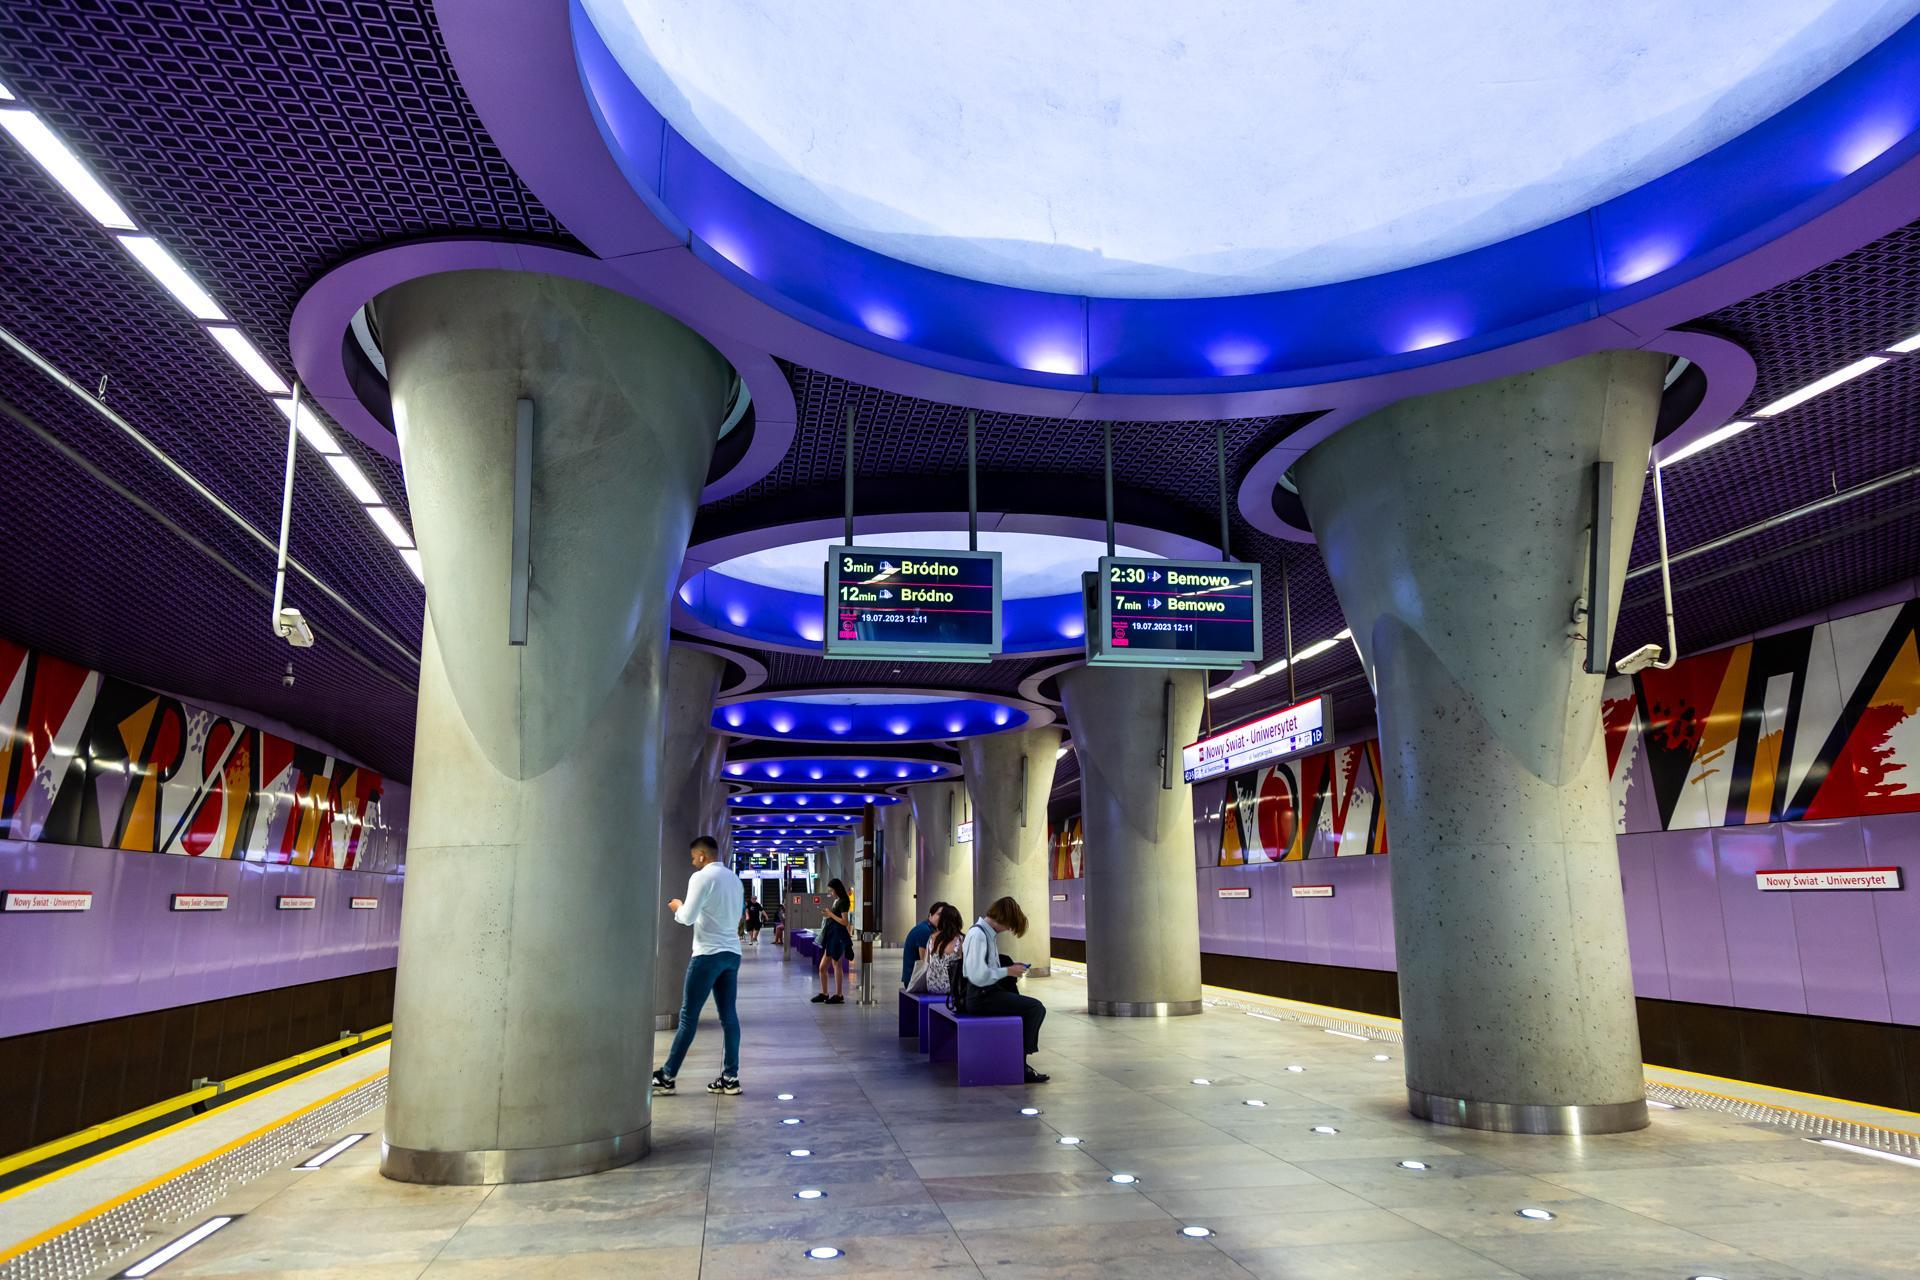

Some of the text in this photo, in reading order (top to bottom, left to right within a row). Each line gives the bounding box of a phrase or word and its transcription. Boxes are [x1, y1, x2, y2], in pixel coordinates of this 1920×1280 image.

[843, 557, 959, 576] 3min Bródno
[1110, 567, 1230, 586] 2:30 Bemowo
[840, 586, 954, 603] 12min Bródno
[1115, 596, 1225, 612] 7min Bemowo
[861, 614, 905, 623] 19.07.2023
[906, 615, 928, 624] 12:11
[1132, 622, 1172, 631] 19.07.2023
[1173, 623, 1193, 632] 12:11
[1206, 744, 1224, 759] Nowy
[1250, 715, 1298, 744] Uniwersytet
[1766, 877, 1791, 888] Nowy
[1793, 874, 1819, 886] Świat
[1826, 875, 1886, 887] Uniwersytet
[13, 897, 31, 908] Nowy
